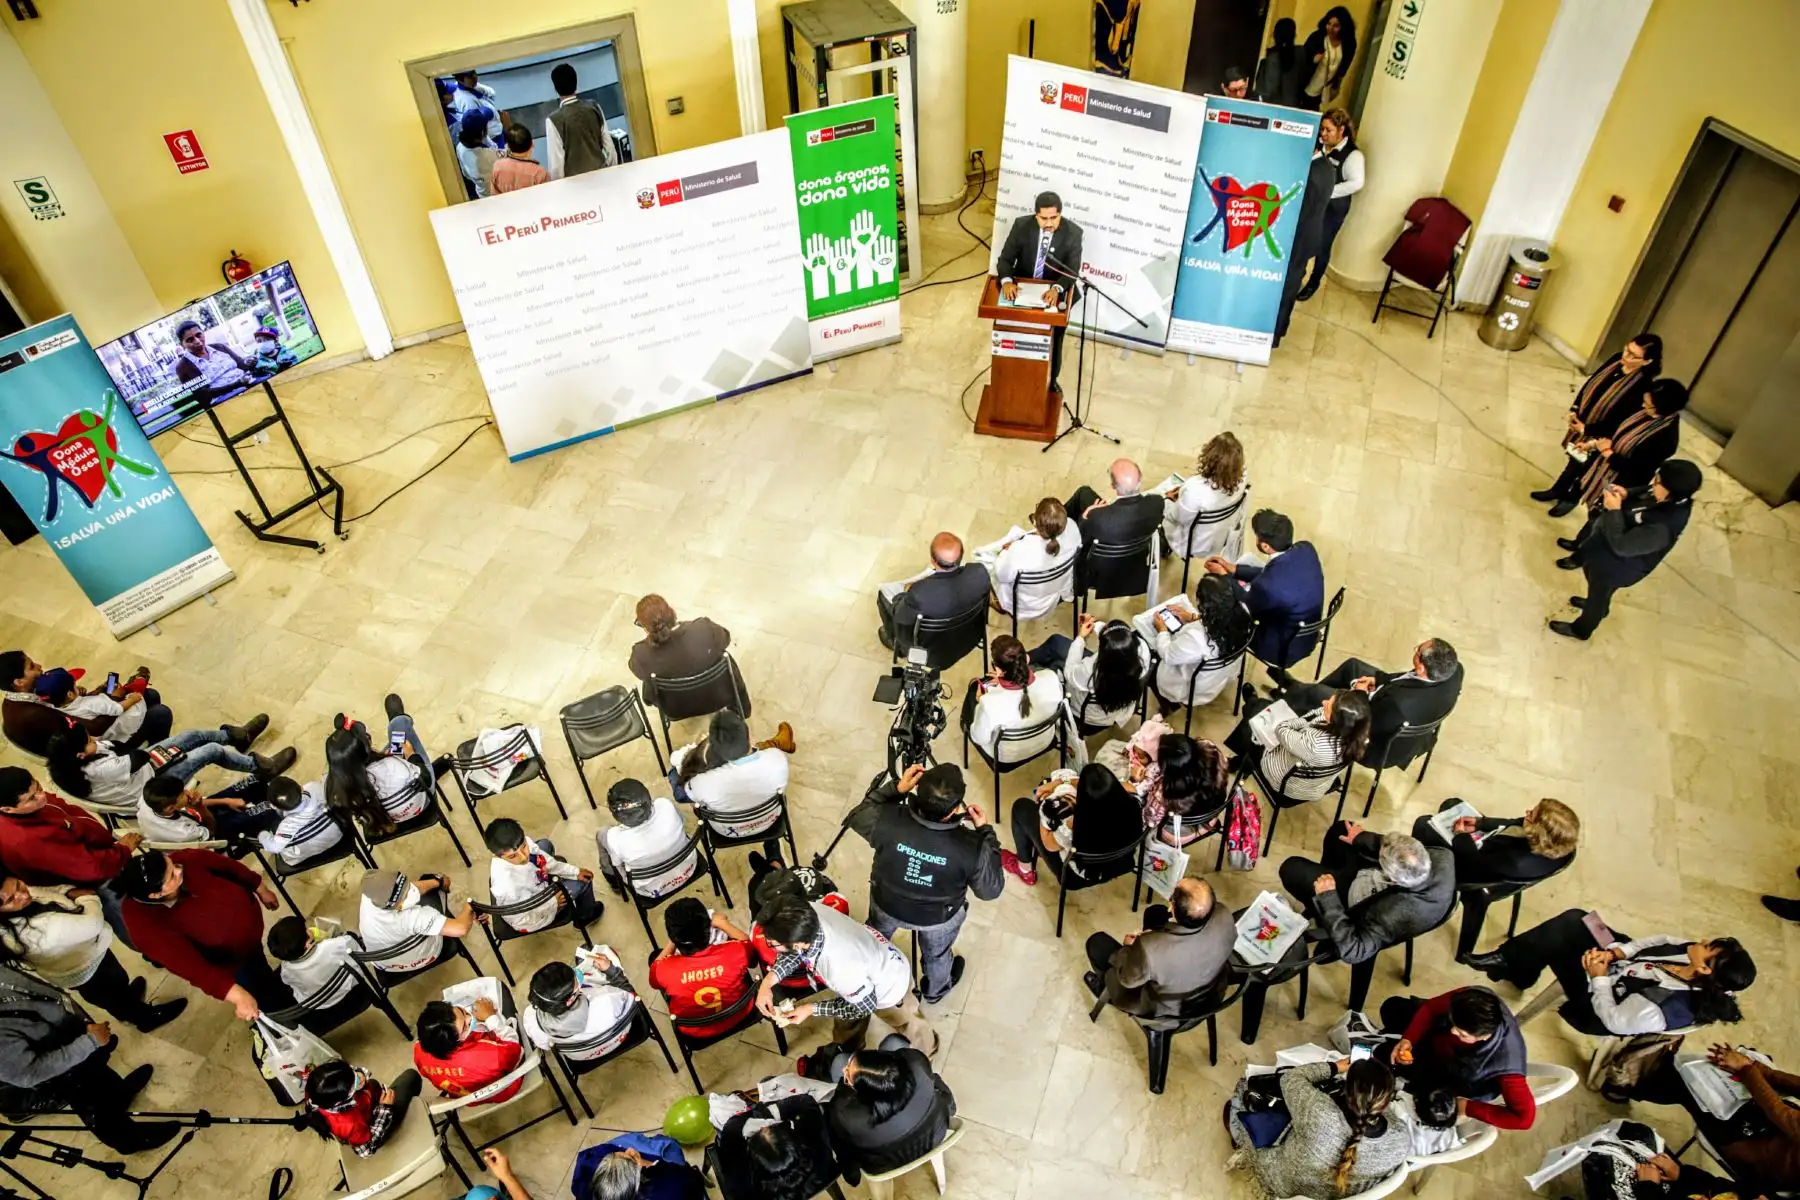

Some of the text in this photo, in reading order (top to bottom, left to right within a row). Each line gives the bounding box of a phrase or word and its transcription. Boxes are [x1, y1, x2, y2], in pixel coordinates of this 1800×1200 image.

[1392, 40, 1408, 62] S
[1064, 92, 1152, 118] PERÚ Ministerio de Salud
[180, 161, 206, 172] EXTINTOR
[660, 187, 680, 197] PERÚ
[685, 180, 716, 191] Ministerio
[724, 172, 742, 182] Salud
[798, 164, 890, 192] dona órganos,
[24, 182, 50, 204] S
[799, 175, 890, 206] dona vida
[1226, 208, 1258, 218] Médula
[1232, 200, 1254, 208] Dona
[1232, 216, 1256, 227] Ósea
[1225, 264, 1248, 276] UNA
[52, 441, 83, 460] Dona
[56, 447, 96, 473] Médula
[71, 457, 100, 477] Ósea
[54, 485, 176, 550] ¡SALVA UNA VIDA!
[896, 843, 948, 866] OPERACIONES
[904, 876, 933, 888] Latina
[681, 964, 724, 984] JHOSEP
[694, 986, 722, 1012] 9
